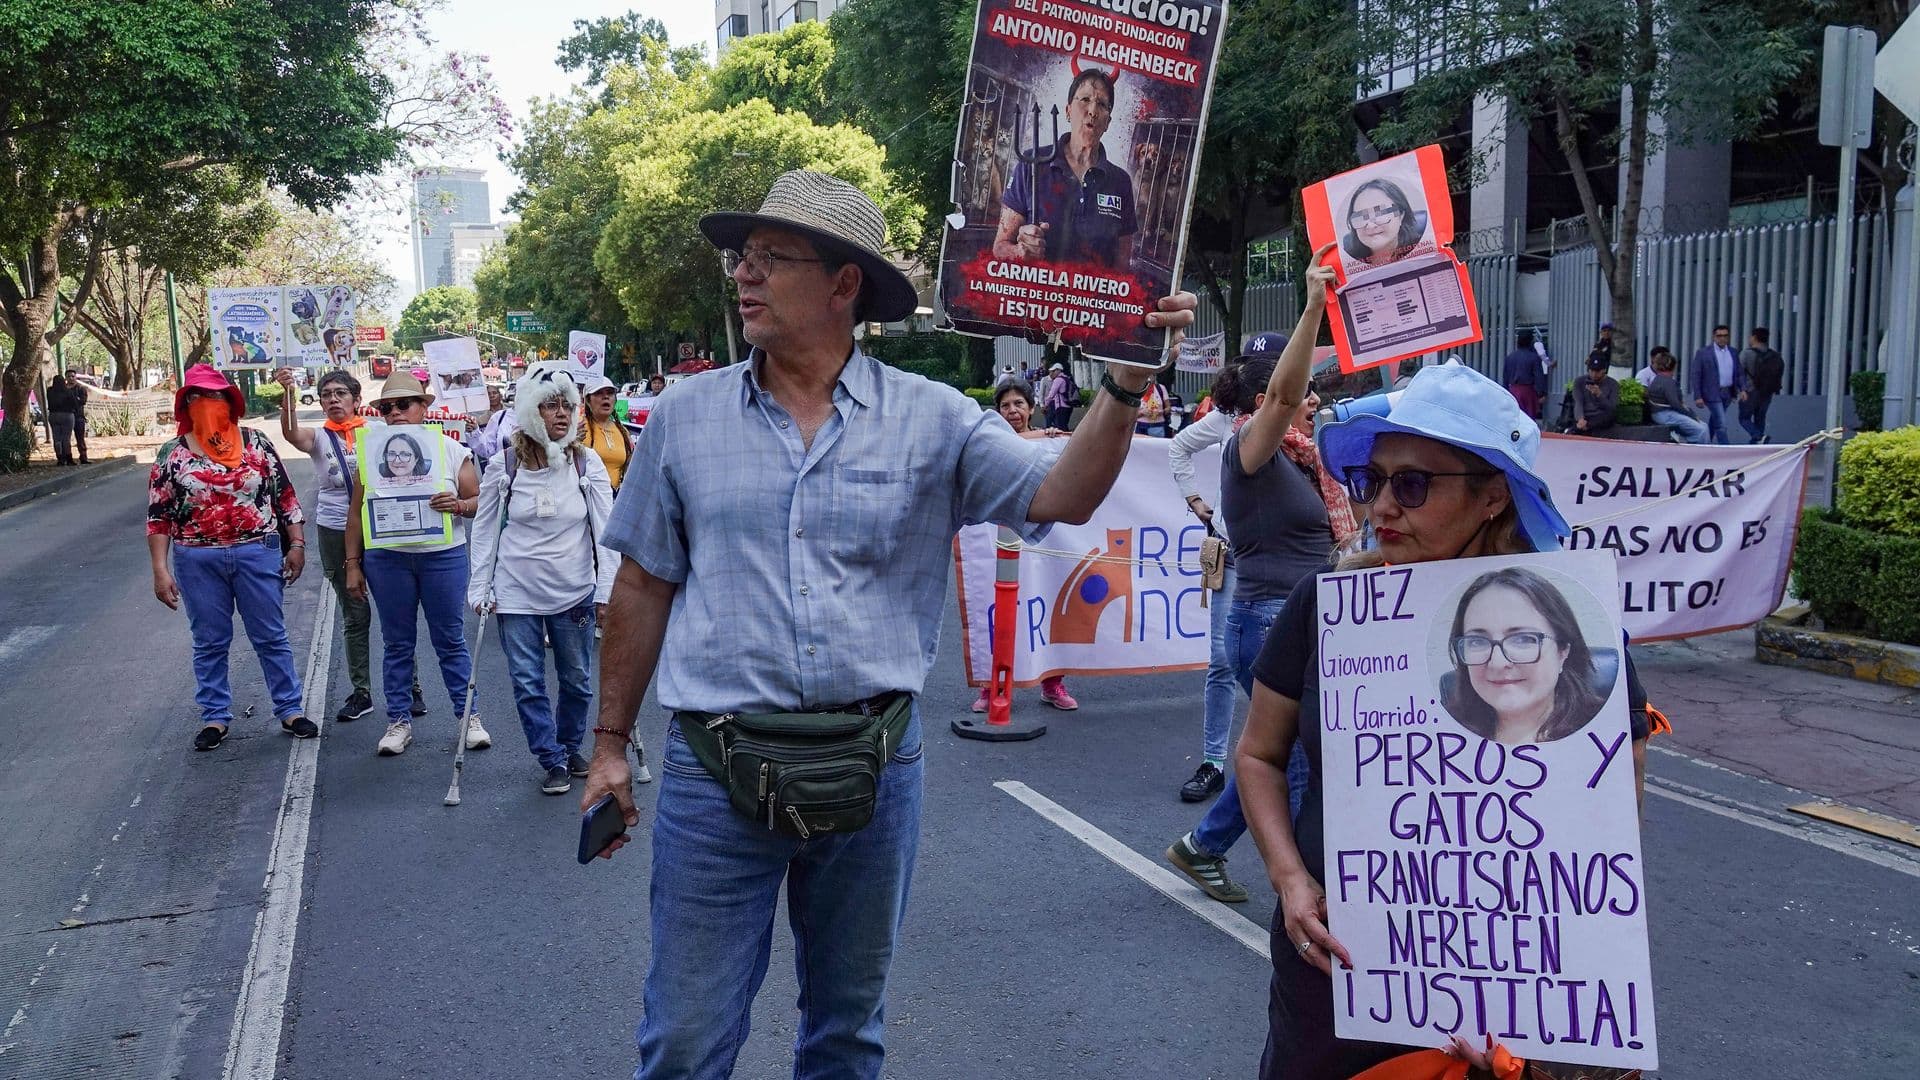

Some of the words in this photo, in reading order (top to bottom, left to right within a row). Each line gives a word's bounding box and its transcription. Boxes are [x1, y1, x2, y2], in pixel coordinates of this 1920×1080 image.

[992, 14, 1077, 51] ANTONIO
[1080, 36, 1198, 84] HAGHENBECK
[1014, 0, 1039, 13] DEL
[1041, 1, 1113, 31] PATRONATO
[1114, 21, 1186, 51] FUNDACIÓN
[970, 280, 983, 291] LA
[985, 282, 1027, 297] MUERTE
[1029, 289, 1043, 300] DE
[1044, 291, 1064, 303] LOS
[1065, 295, 1144, 315] FRANCISCANITOS
[987, 260, 1069, 288] CARMELA
[1073, 273, 1130, 297] RIVERO
[1052, 307, 1105, 329] CULPA!
[1575, 466, 1746, 505] ¡SALVAR
[1568, 525, 1650, 557] DAS
[1659, 522, 1723, 554] NO
[1740, 515, 1771, 551] ES
[1322, 568, 1415, 626] JUEZ
[1622, 578, 1725, 613] LITO!
[1320, 628, 1409, 678] Giovanna
[1323, 690, 1348, 732] U.
[1354, 685, 1439, 731] Garrido:
[1355, 732, 1548, 790] PERROS
[1586, 731, 1628, 789] Y
[1389, 791, 1545, 850] GATOS
[1337, 850, 1640, 917] FRANCISCANOS
[1387, 910, 1562, 975] MERECEN
